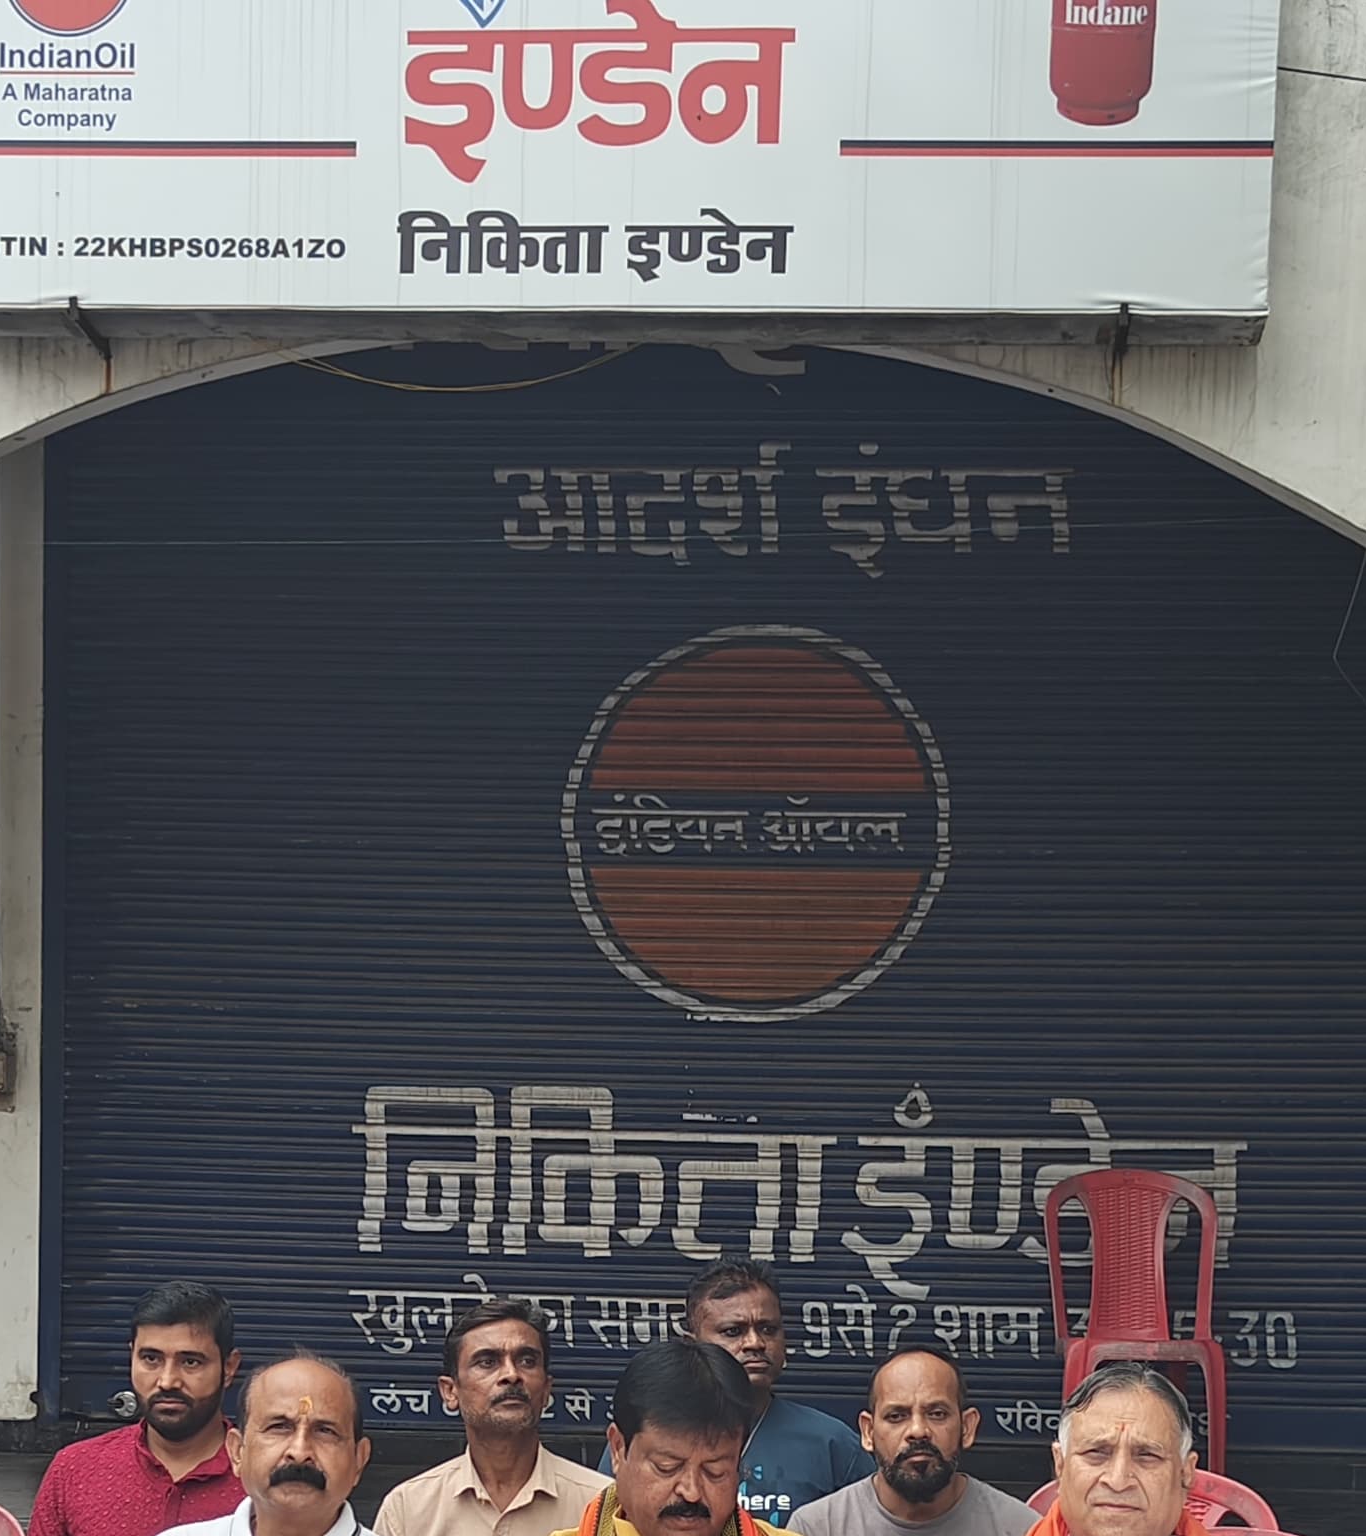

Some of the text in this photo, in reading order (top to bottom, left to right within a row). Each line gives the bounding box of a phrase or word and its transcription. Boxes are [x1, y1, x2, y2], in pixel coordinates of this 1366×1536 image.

[1065, 0, 1148, 25] Indane
[0, 43, 136, 69] IndianOil
[2, 83, 133, 101] A Maharatna
[404, 0, 796, 183] इण्डेन
[17, 109, 117, 131] Company
[397, 208, 794, 282] निकिता इण्डेन
[493, 441, 792, 565] आदर्श
[351, 1086, 838, 1262] निकिता
[933, 1305, 1045, 1360] शाम
[370, 1383, 431, 1416] लंच
[565, 1388, 596, 1421] से
